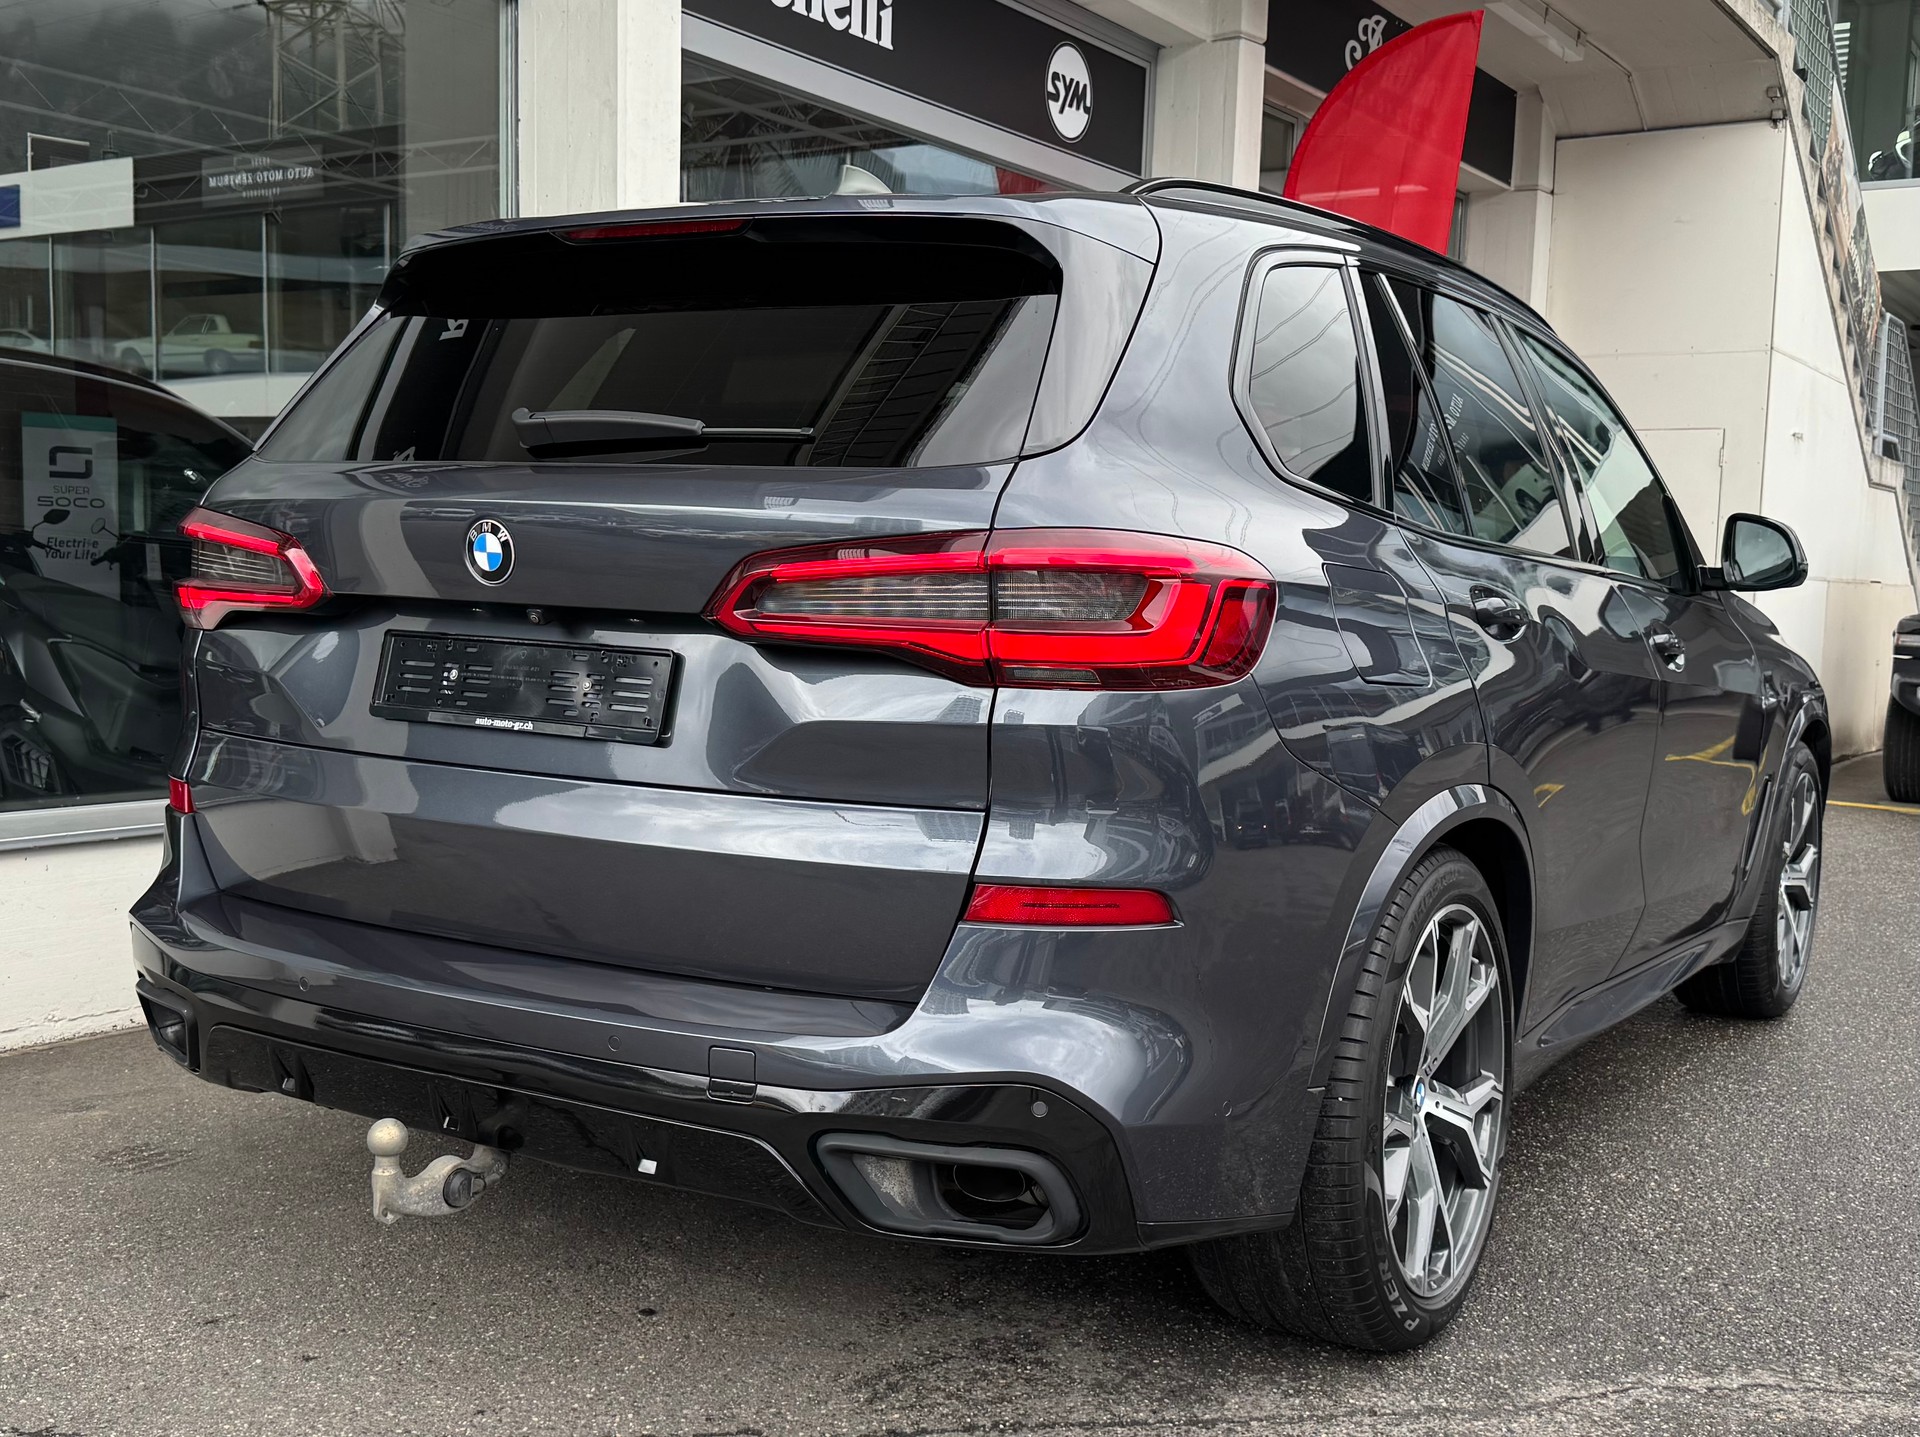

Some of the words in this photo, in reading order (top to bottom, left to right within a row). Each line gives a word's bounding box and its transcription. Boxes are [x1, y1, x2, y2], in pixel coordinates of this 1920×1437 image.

[1047, 71, 1091, 115] SYM
[53, 485, 90, 495] SUPER
[37, 496, 105, 508] SOCO
[469, 522, 508, 543] BMW
[44, 547, 71, 559] Your
[474, 717, 534, 731] auto-moto-gr.ch
[1403, 1317, 1420, 1331] P
